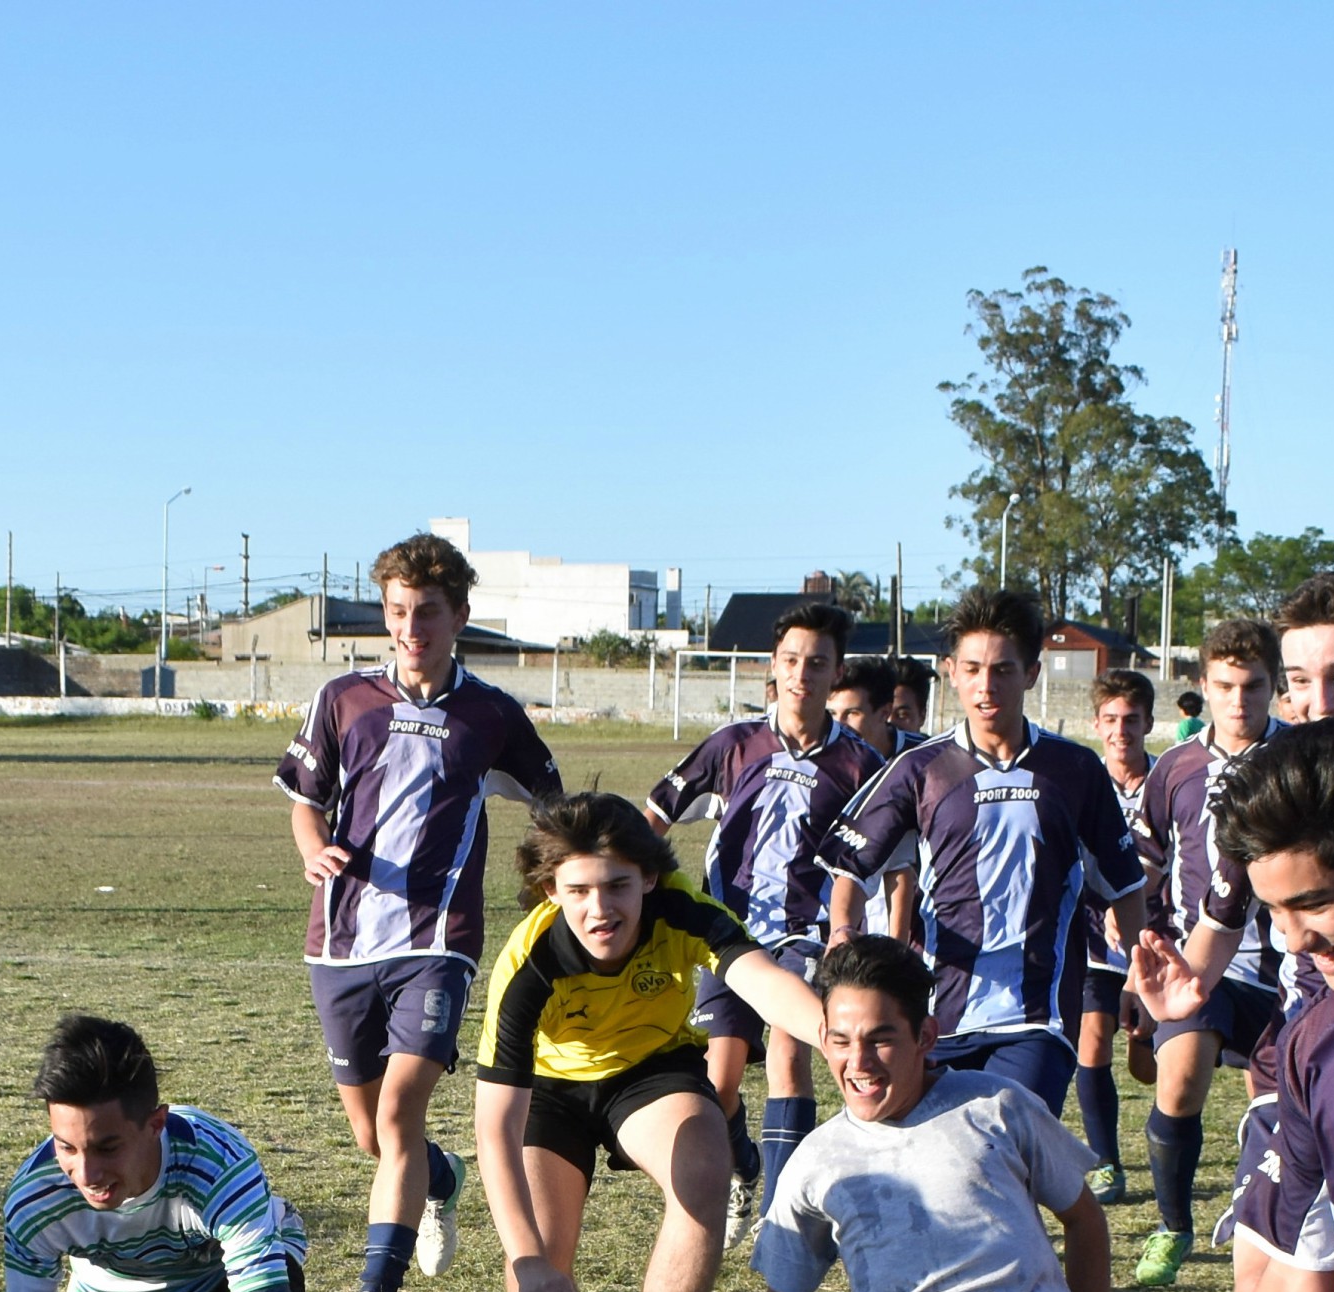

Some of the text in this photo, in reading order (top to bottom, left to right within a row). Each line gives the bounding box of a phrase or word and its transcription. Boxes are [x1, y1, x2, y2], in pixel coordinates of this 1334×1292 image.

[388, 720, 450, 740] SPORT 2000
[765, 768, 818, 788] SPORT 2000
[974, 788, 1041, 803] SPORT 2000
[638, 975, 666, 992] BVB
[420, 988, 452, 1033] 9
